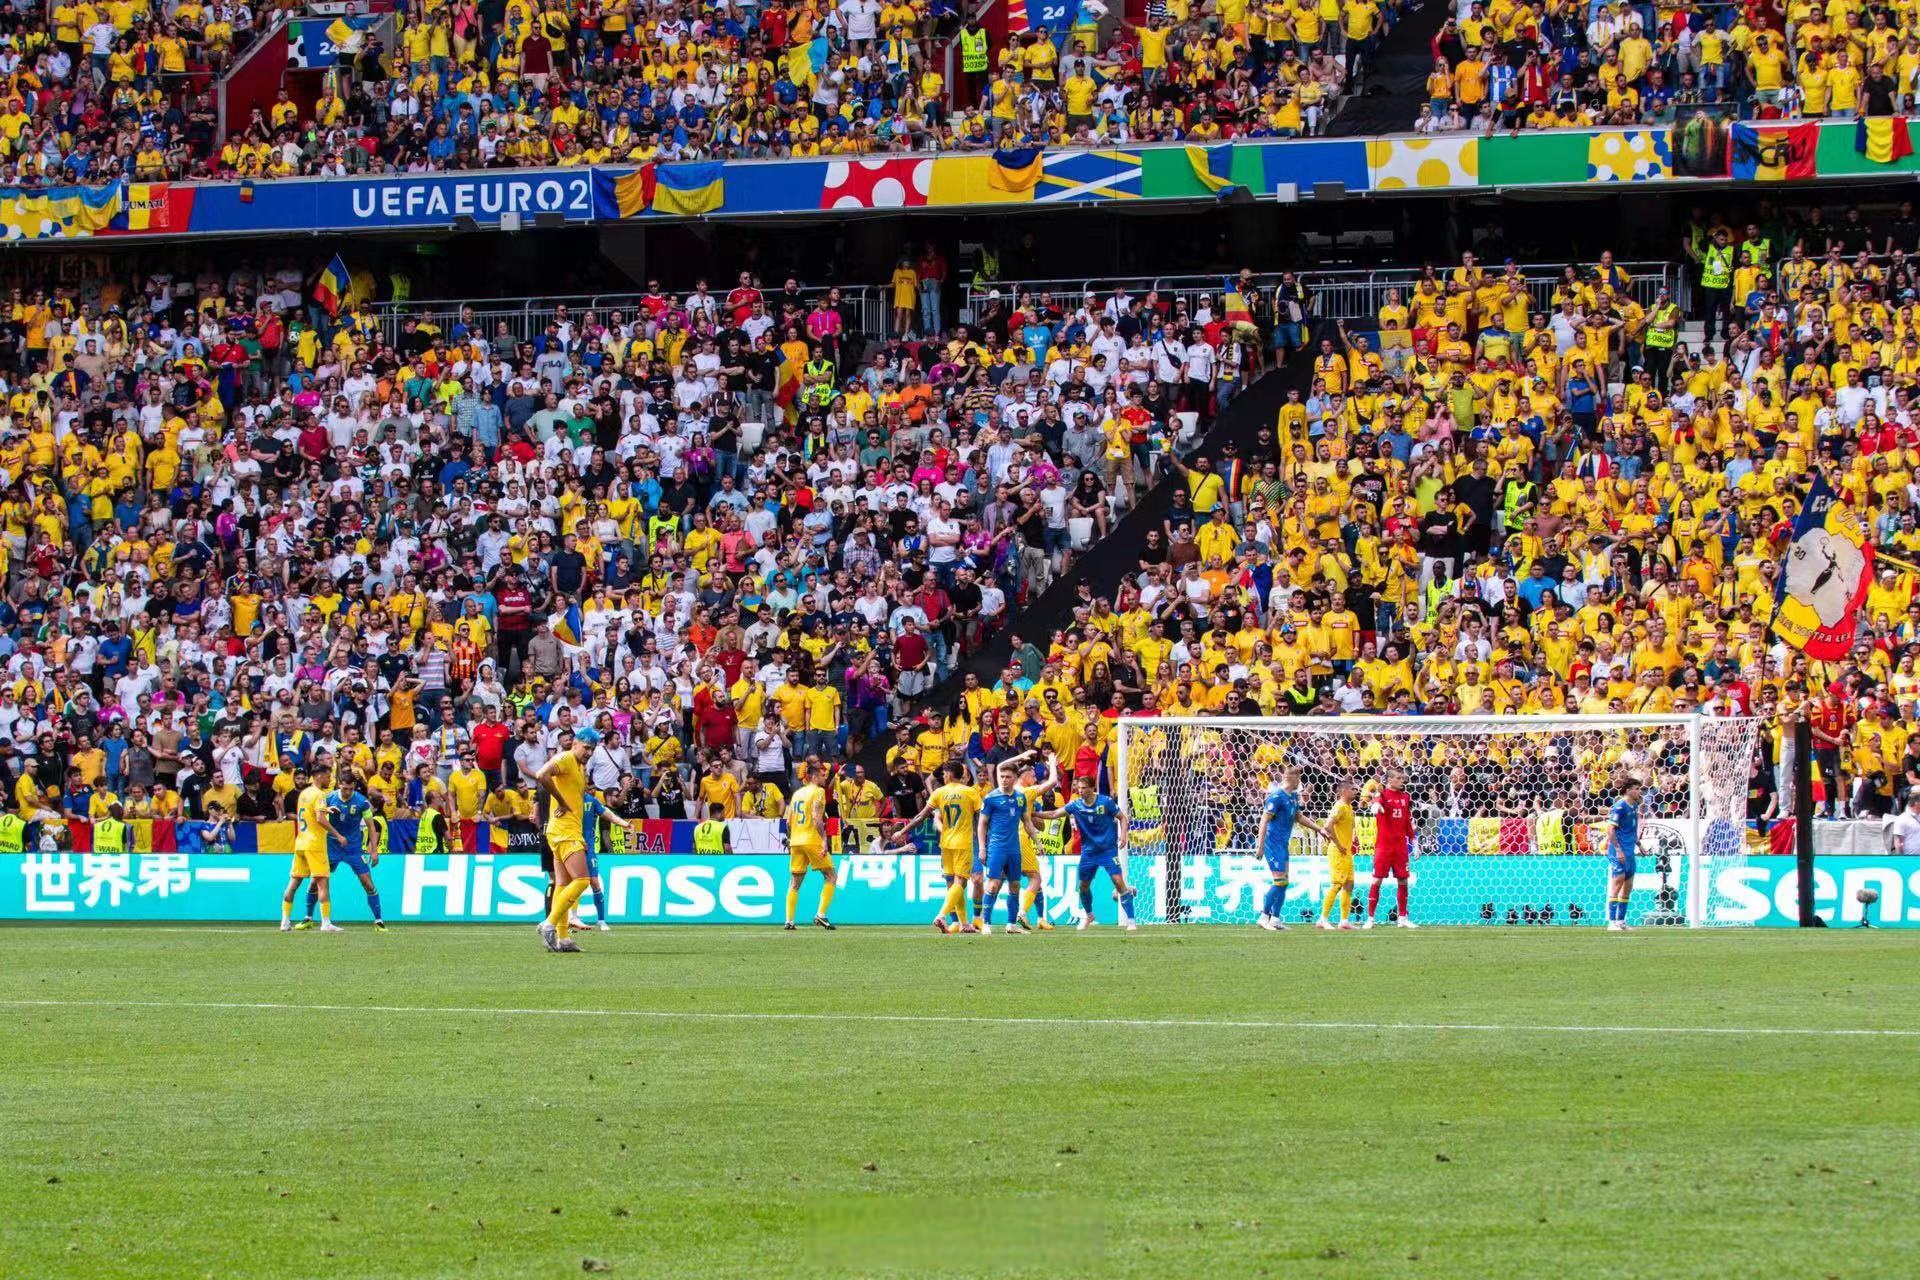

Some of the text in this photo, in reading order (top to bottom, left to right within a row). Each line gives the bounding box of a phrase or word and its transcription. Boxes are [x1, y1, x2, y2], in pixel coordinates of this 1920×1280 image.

[1042, 6, 1065, 20] 24
[349, 804, 357, 815] 6
[583, 801, 593, 811] 17
[794, 800, 806, 825] 15
[943, 802, 962, 830] 17
[1392, 808, 1403, 819] 23
[298, 807, 308, 832] 5
[21, 853, 250, 912] 世界第一
[401, 854, 775, 918] Hisnse
